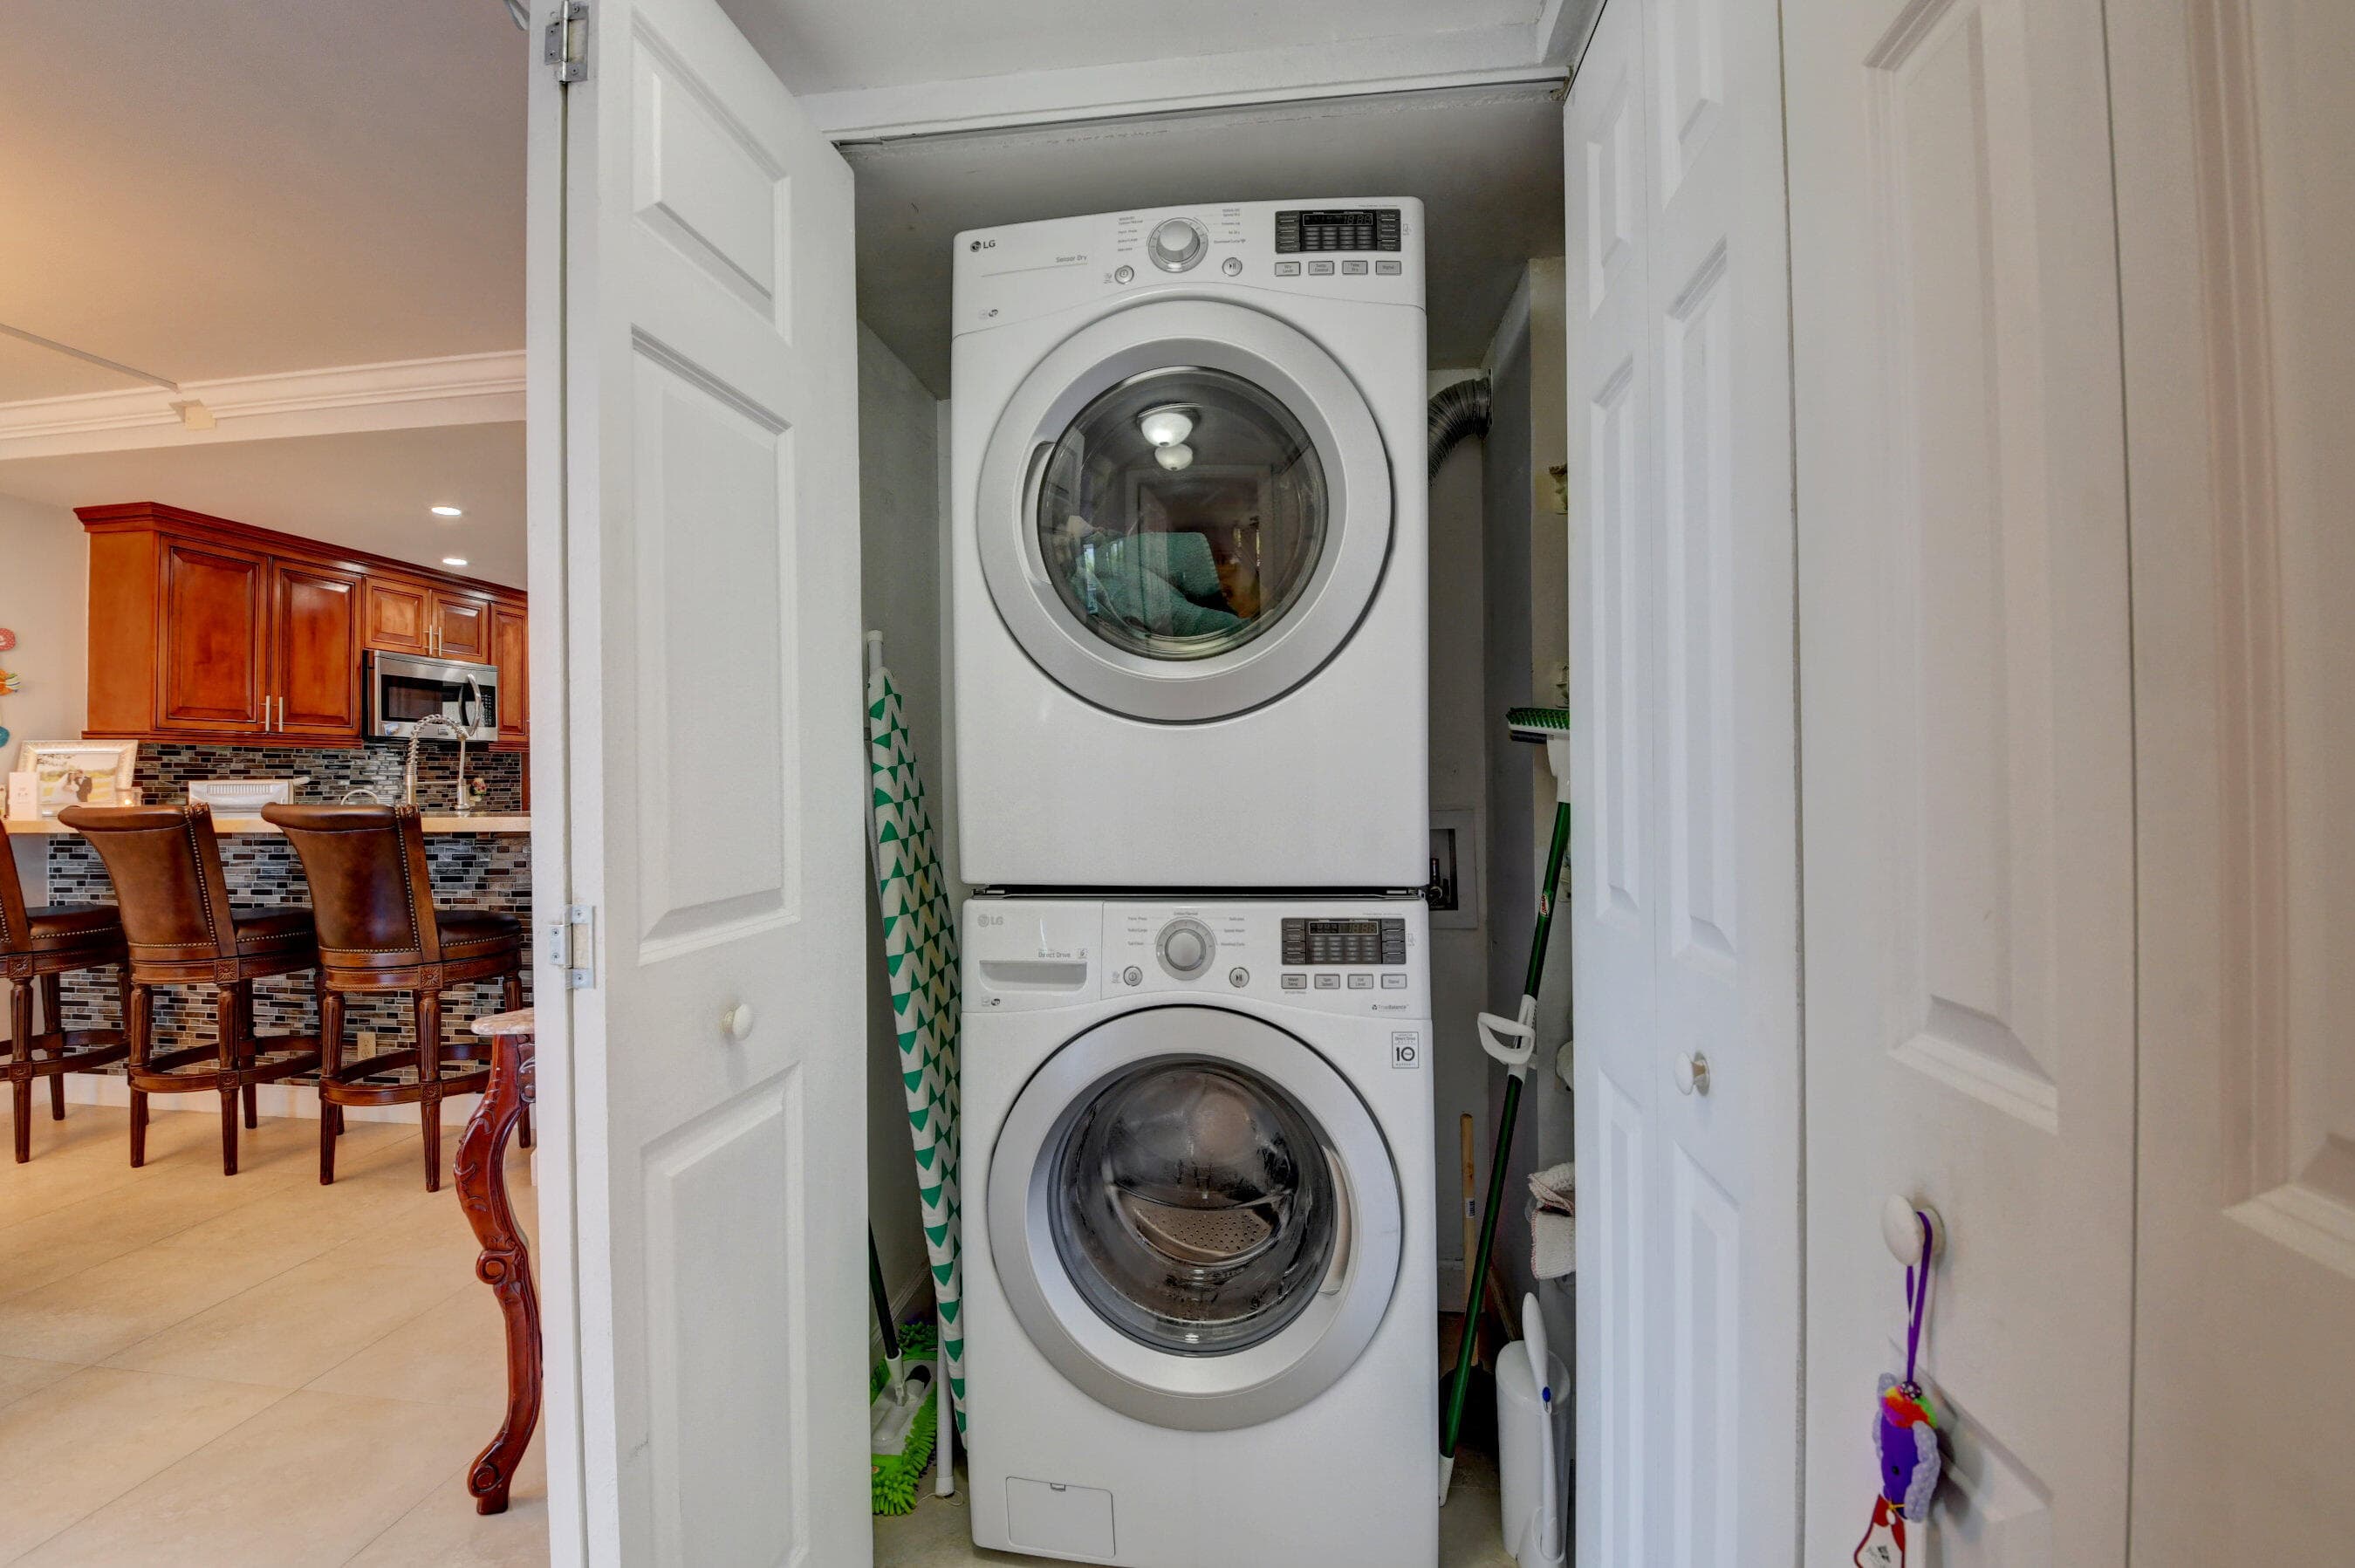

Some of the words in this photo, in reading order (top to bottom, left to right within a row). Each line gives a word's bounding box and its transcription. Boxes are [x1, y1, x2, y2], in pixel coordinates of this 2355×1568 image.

[982, 240, 996, 249] LG
[991, 916, 1003, 926] LG
[1396, 1046, 1415, 1062] 10
